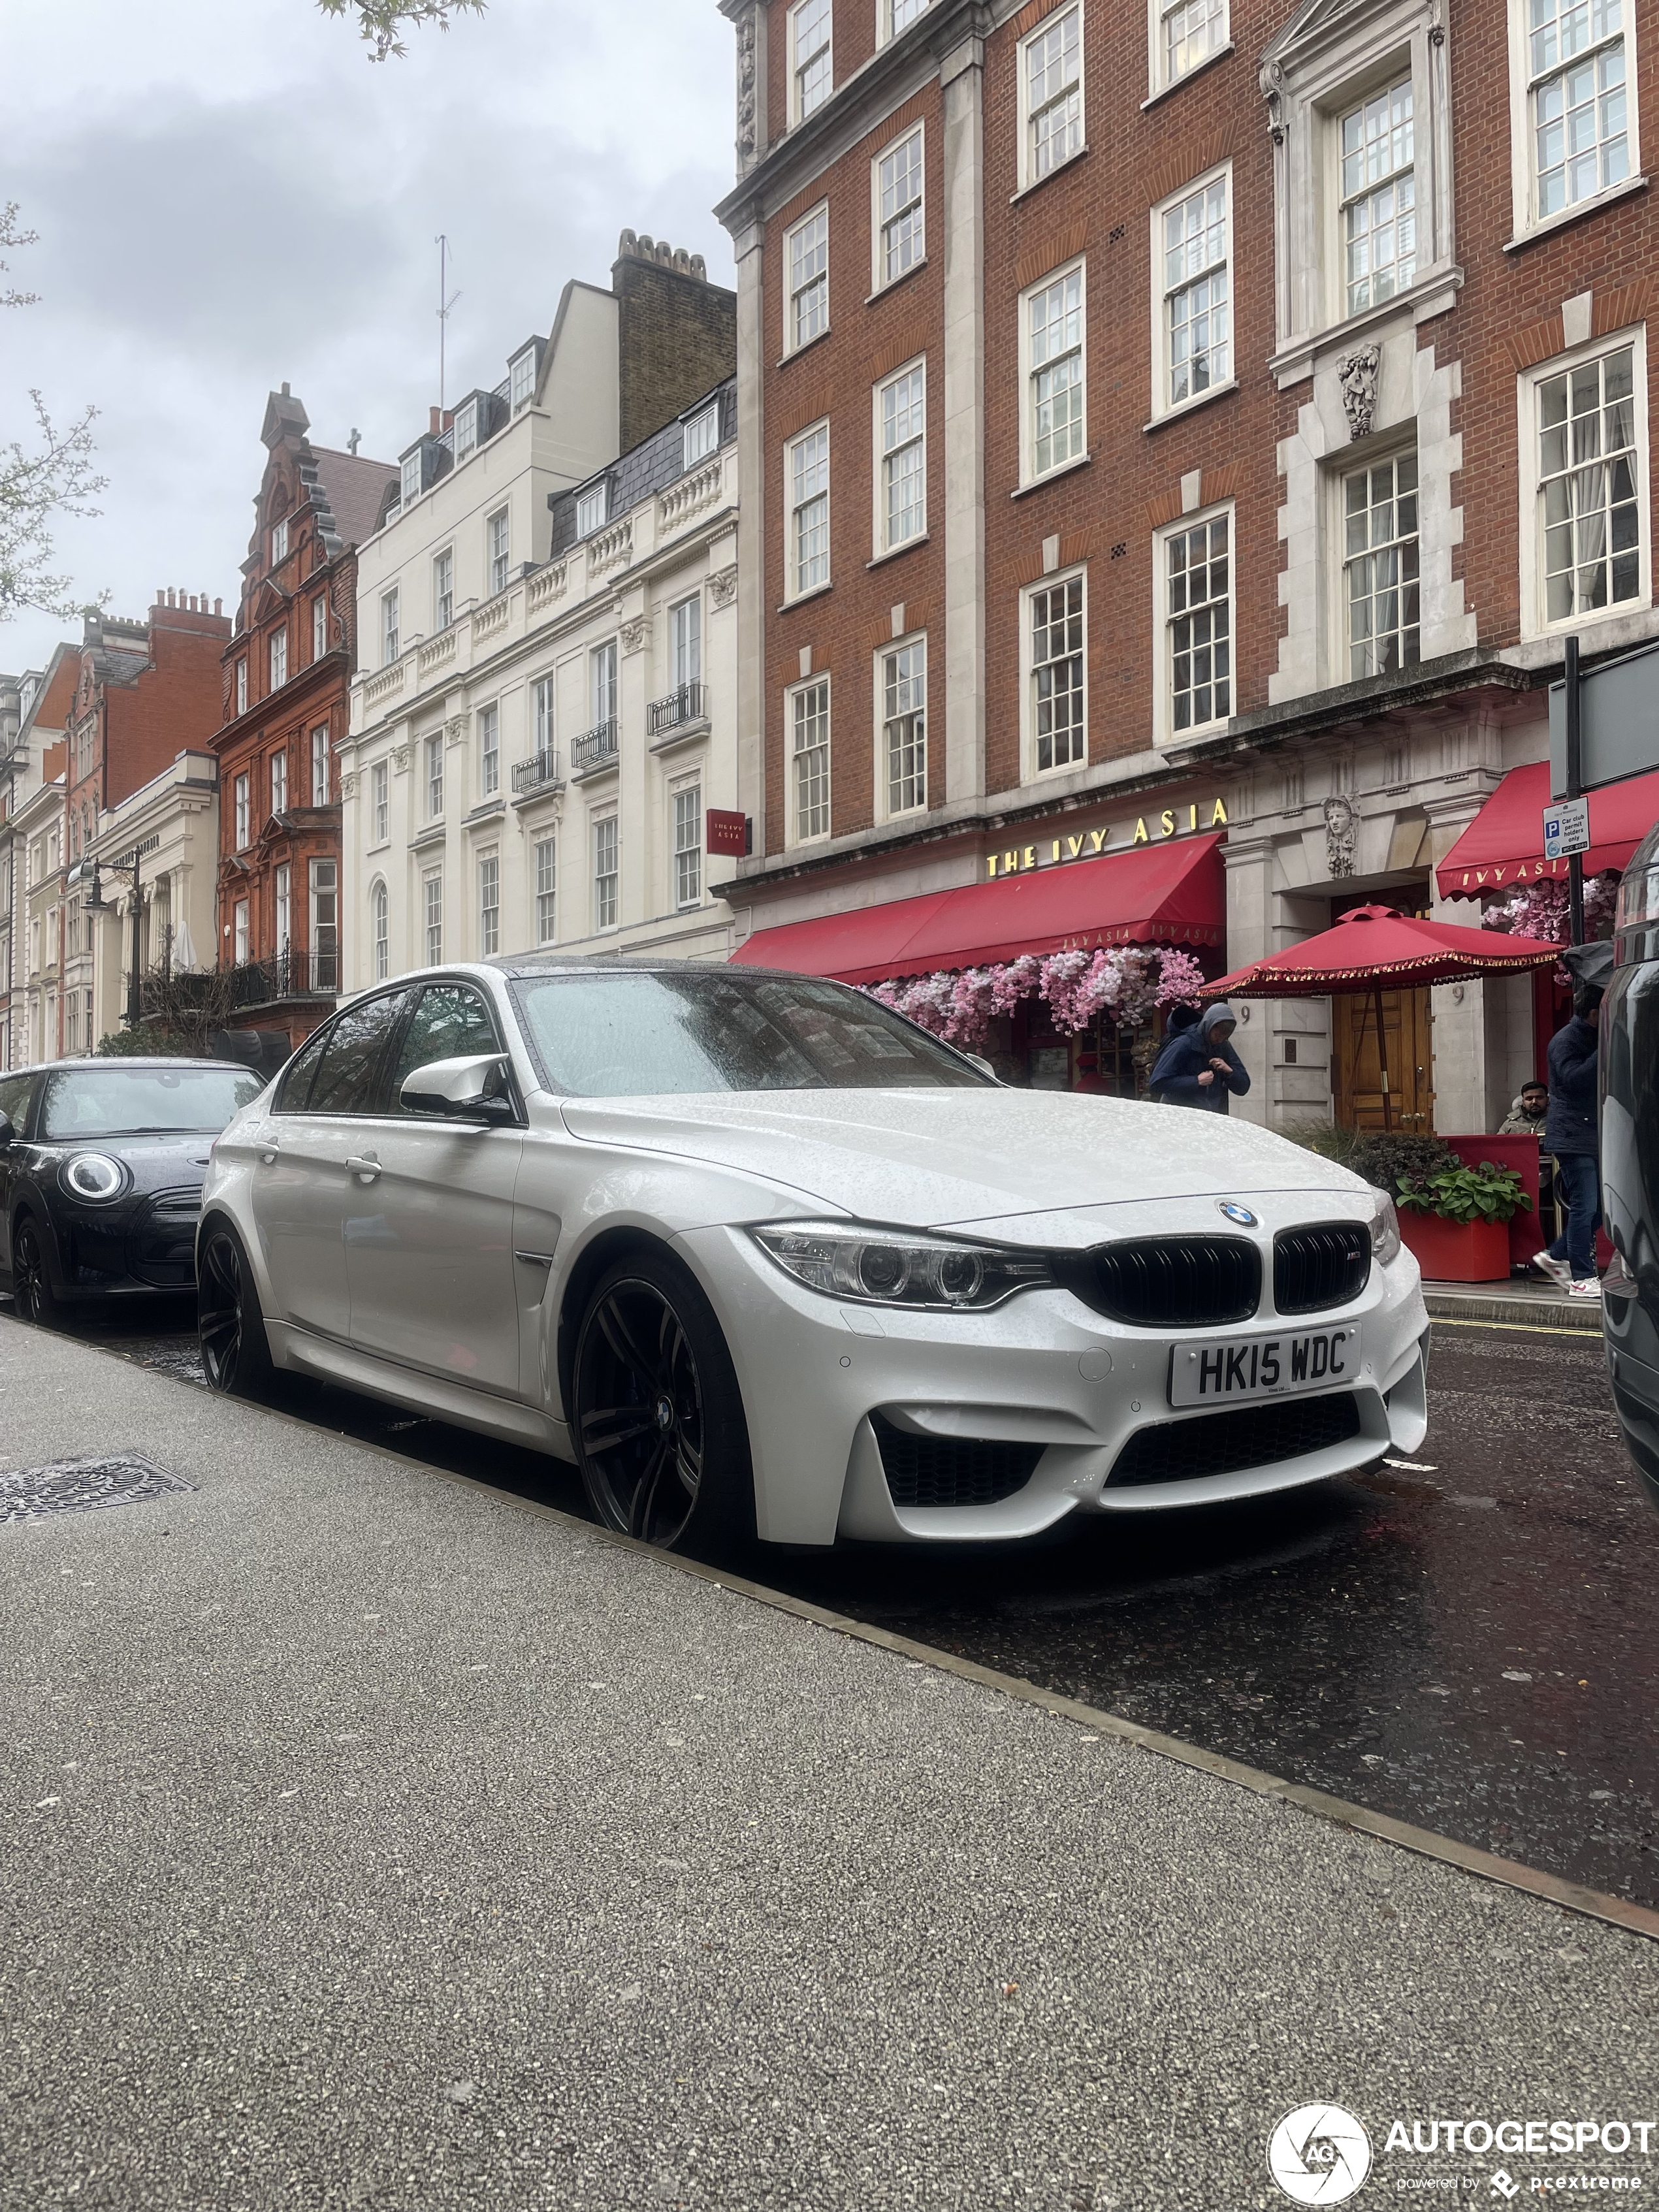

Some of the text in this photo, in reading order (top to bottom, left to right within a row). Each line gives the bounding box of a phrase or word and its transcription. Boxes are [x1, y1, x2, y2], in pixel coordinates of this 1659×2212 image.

[1549, 822, 1558, 837] P
[1564, 821, 1582, 831] permit
[1564, 828, 1584, 837] holders
[987, 797, 1228, 876] THE IVY ASIA
[1462, 867, 1507, 886] IVY
[1063, 928, 1129, 949] IVY ASIA
[1152, 924, 1217, 941] IVY ASIA
[1452, 985, 1464, 1006] 9
[1241, 1005, 1250, 1025] 9
[1199, 1332, 1346, 1394] HK15 WDC
